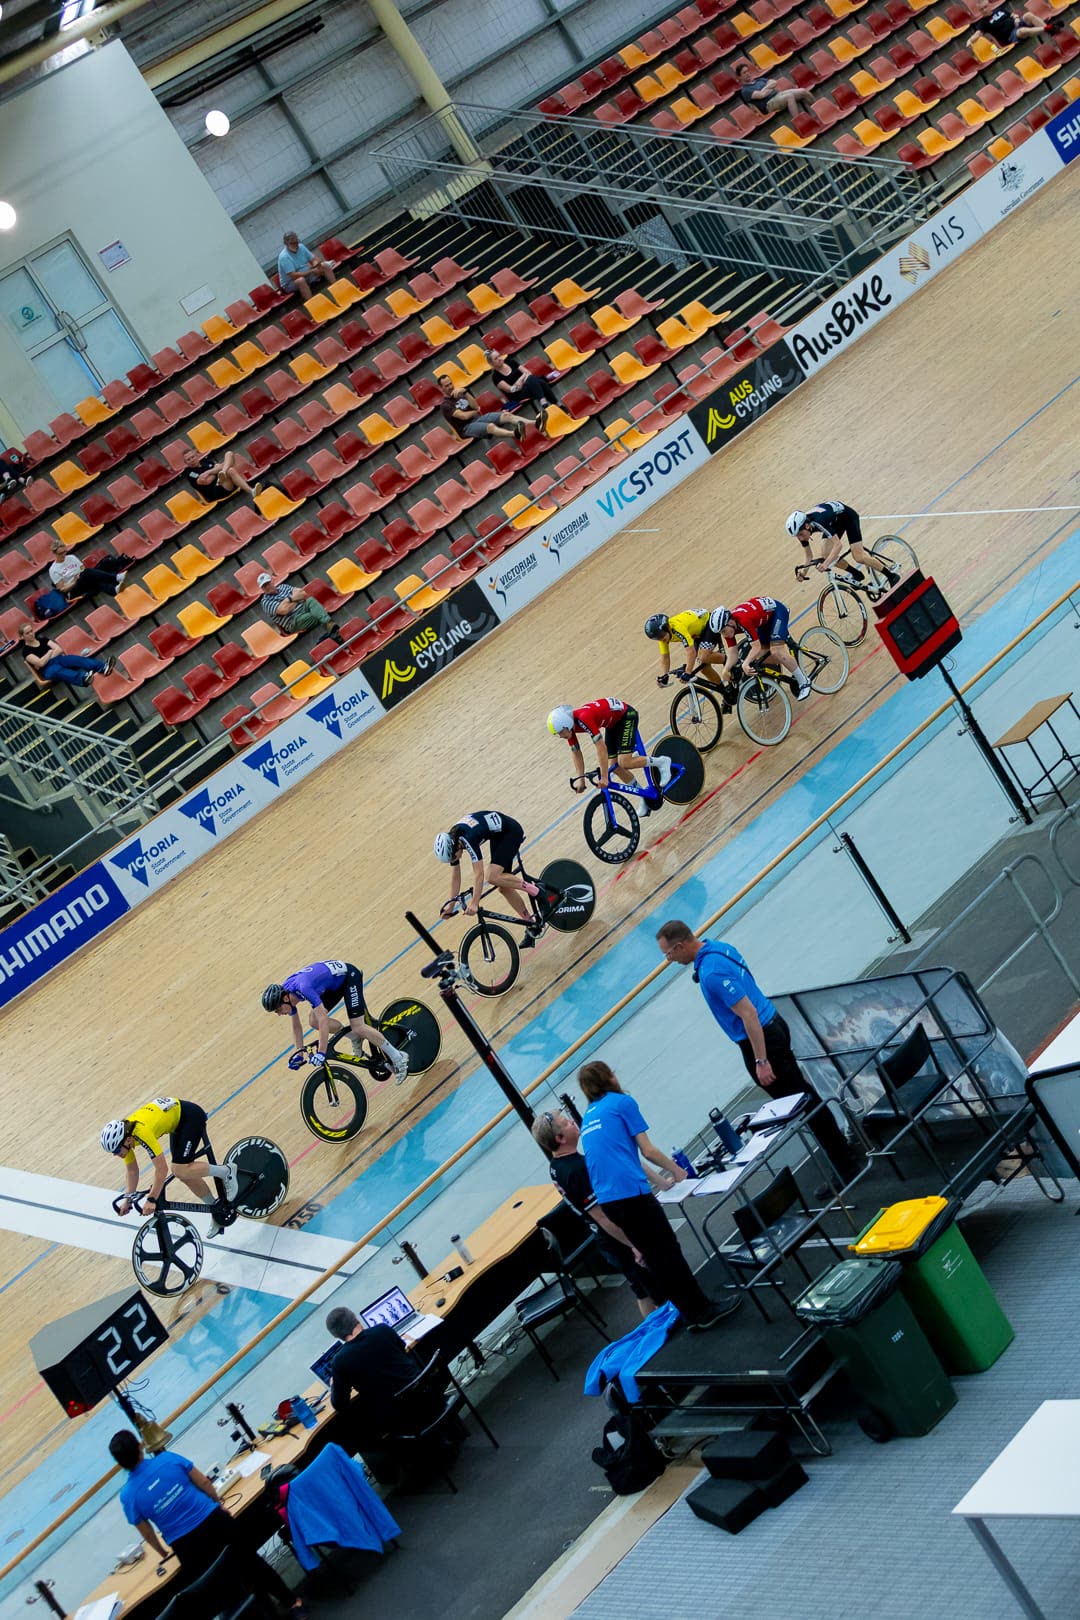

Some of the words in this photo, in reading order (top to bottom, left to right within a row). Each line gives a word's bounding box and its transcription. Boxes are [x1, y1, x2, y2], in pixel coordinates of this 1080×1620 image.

[1020, 176, 1045, 200] Government
[931, 215, 965, 256] AIS
[729, 379, 754, 406] AUS
[735, 374, 783, 418] CYCLING
[596, 429, 694, 517] VICSPORT
[553, 512, 589, 544] VICTORIAN
[499, 552, 537, 585] VICTORIAN
[409, 627, 437, 657] AUS
[416, 620, 472, 669] CYCLING
[322, 689, 370, 729] VICTORIA
[344, 711, 358, 724] State
[347, 705, 376, 729] Government
[621, 720, 631, 747] KIDMAN
[260, 736, 308, 776] VICTORIA
[281, 759, 296, 771] State
[285, 752, 314, 776] Government
[619, 784, 640, 794] TWE
[194, 783, 246, 825] VICTORIA
[218, 807, 233, 819] State
[222, 800, 252, 825] Government
[127, 833, 180, 876] VICTORIA
[151, 857, 166, 870] State
[154, 850, 187, 875] Government
[97, 1303, 157, 1375] 22
